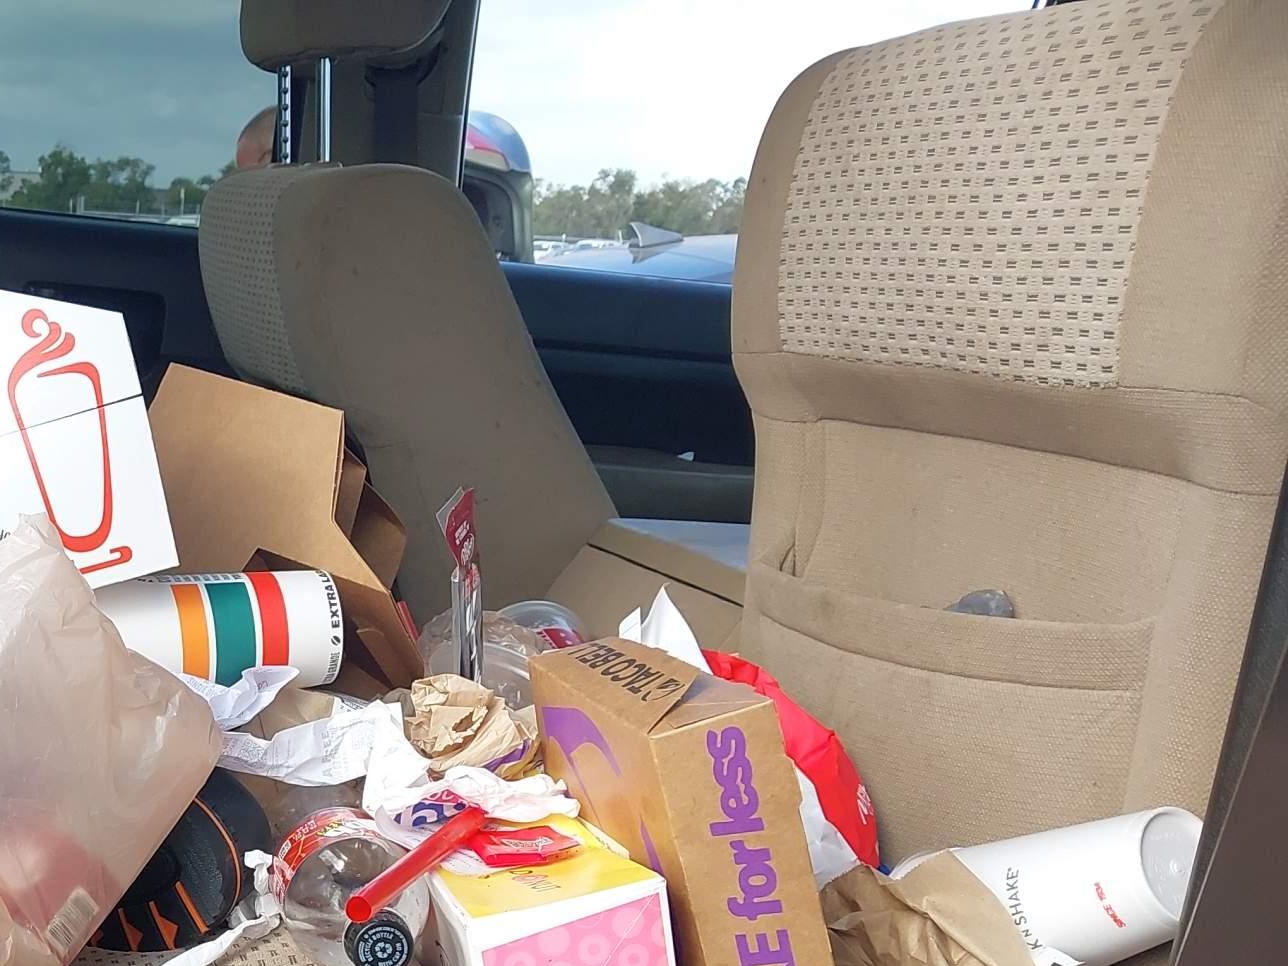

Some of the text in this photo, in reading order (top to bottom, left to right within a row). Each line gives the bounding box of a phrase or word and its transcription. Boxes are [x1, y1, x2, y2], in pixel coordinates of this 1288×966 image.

[325, 584, 340, 628] EXTRA
[568, 643, 664, 694] TACO BELL
[706, 726, 764, 836] less
[728, 831, 784, 921] for
[1006, 868, 1027, 926] SHAKE
